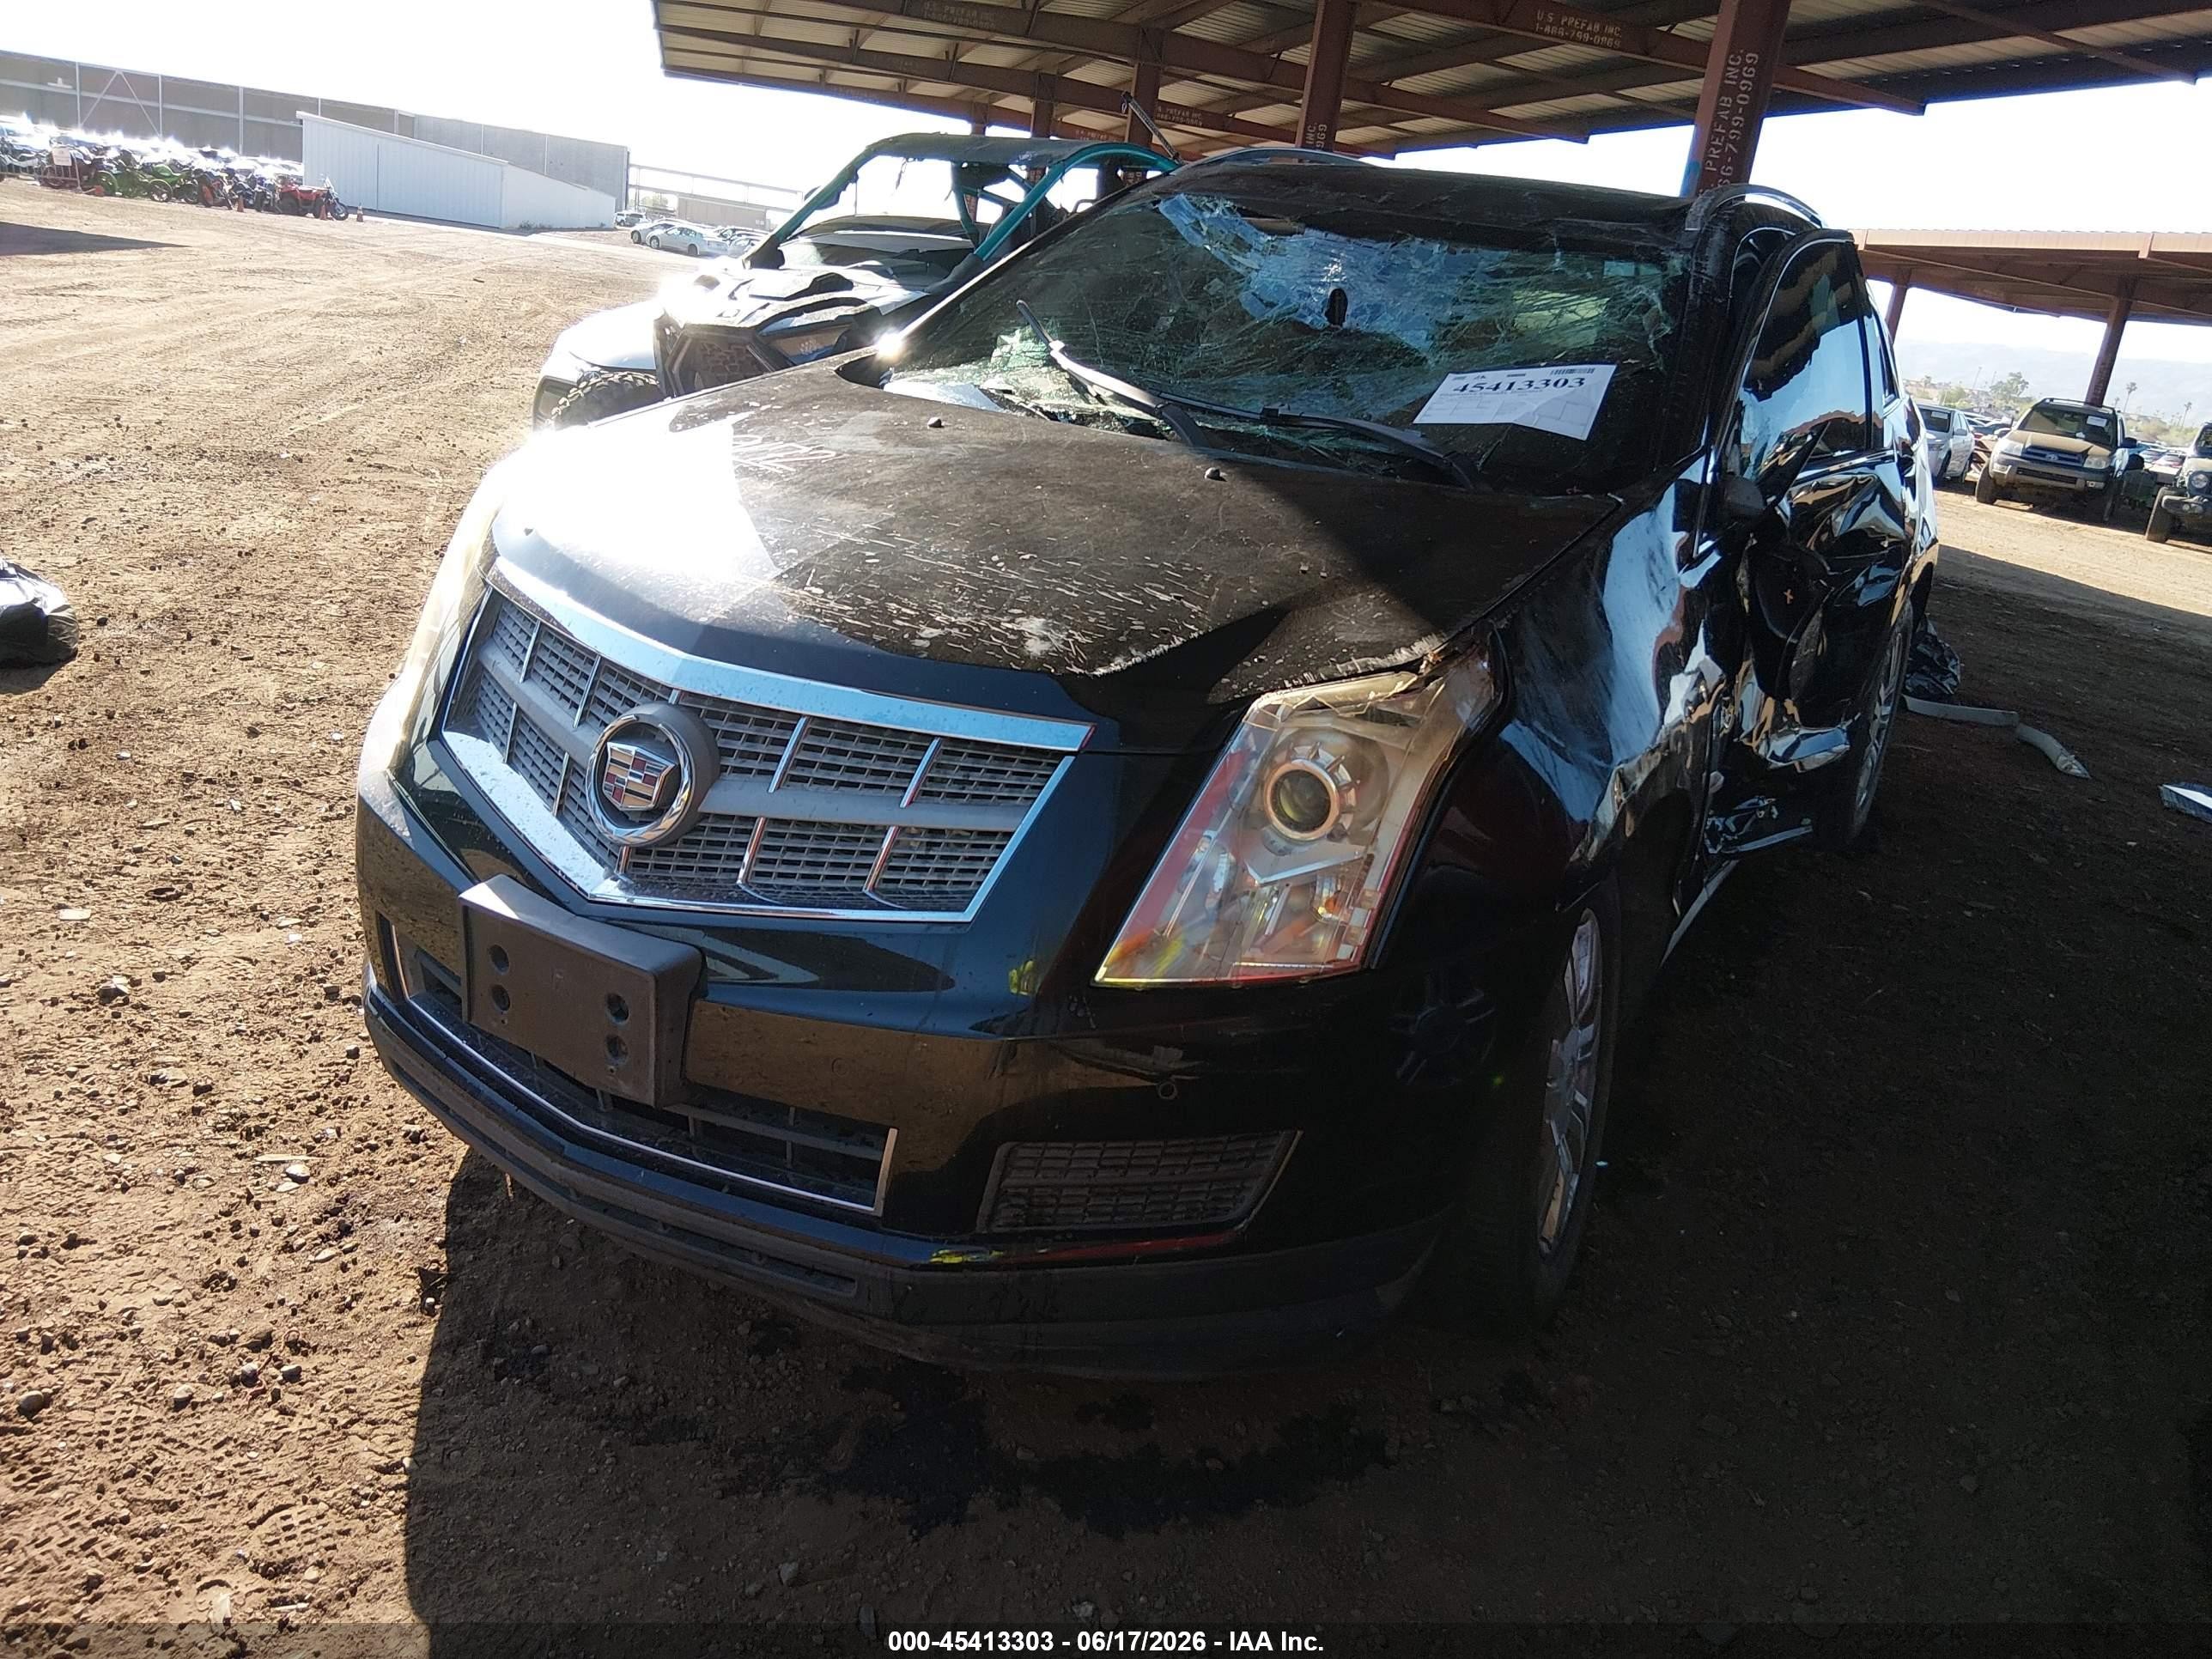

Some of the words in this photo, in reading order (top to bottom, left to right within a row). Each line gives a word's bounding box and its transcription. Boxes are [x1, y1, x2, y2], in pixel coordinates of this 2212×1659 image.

[1561, 15, 1601, 33] PREFAB
[1705, 96, 1733, 171] PREFAB
[1724, 49, 1744, 85] INC.
[1453, 377, 1586, 393] 45413303
